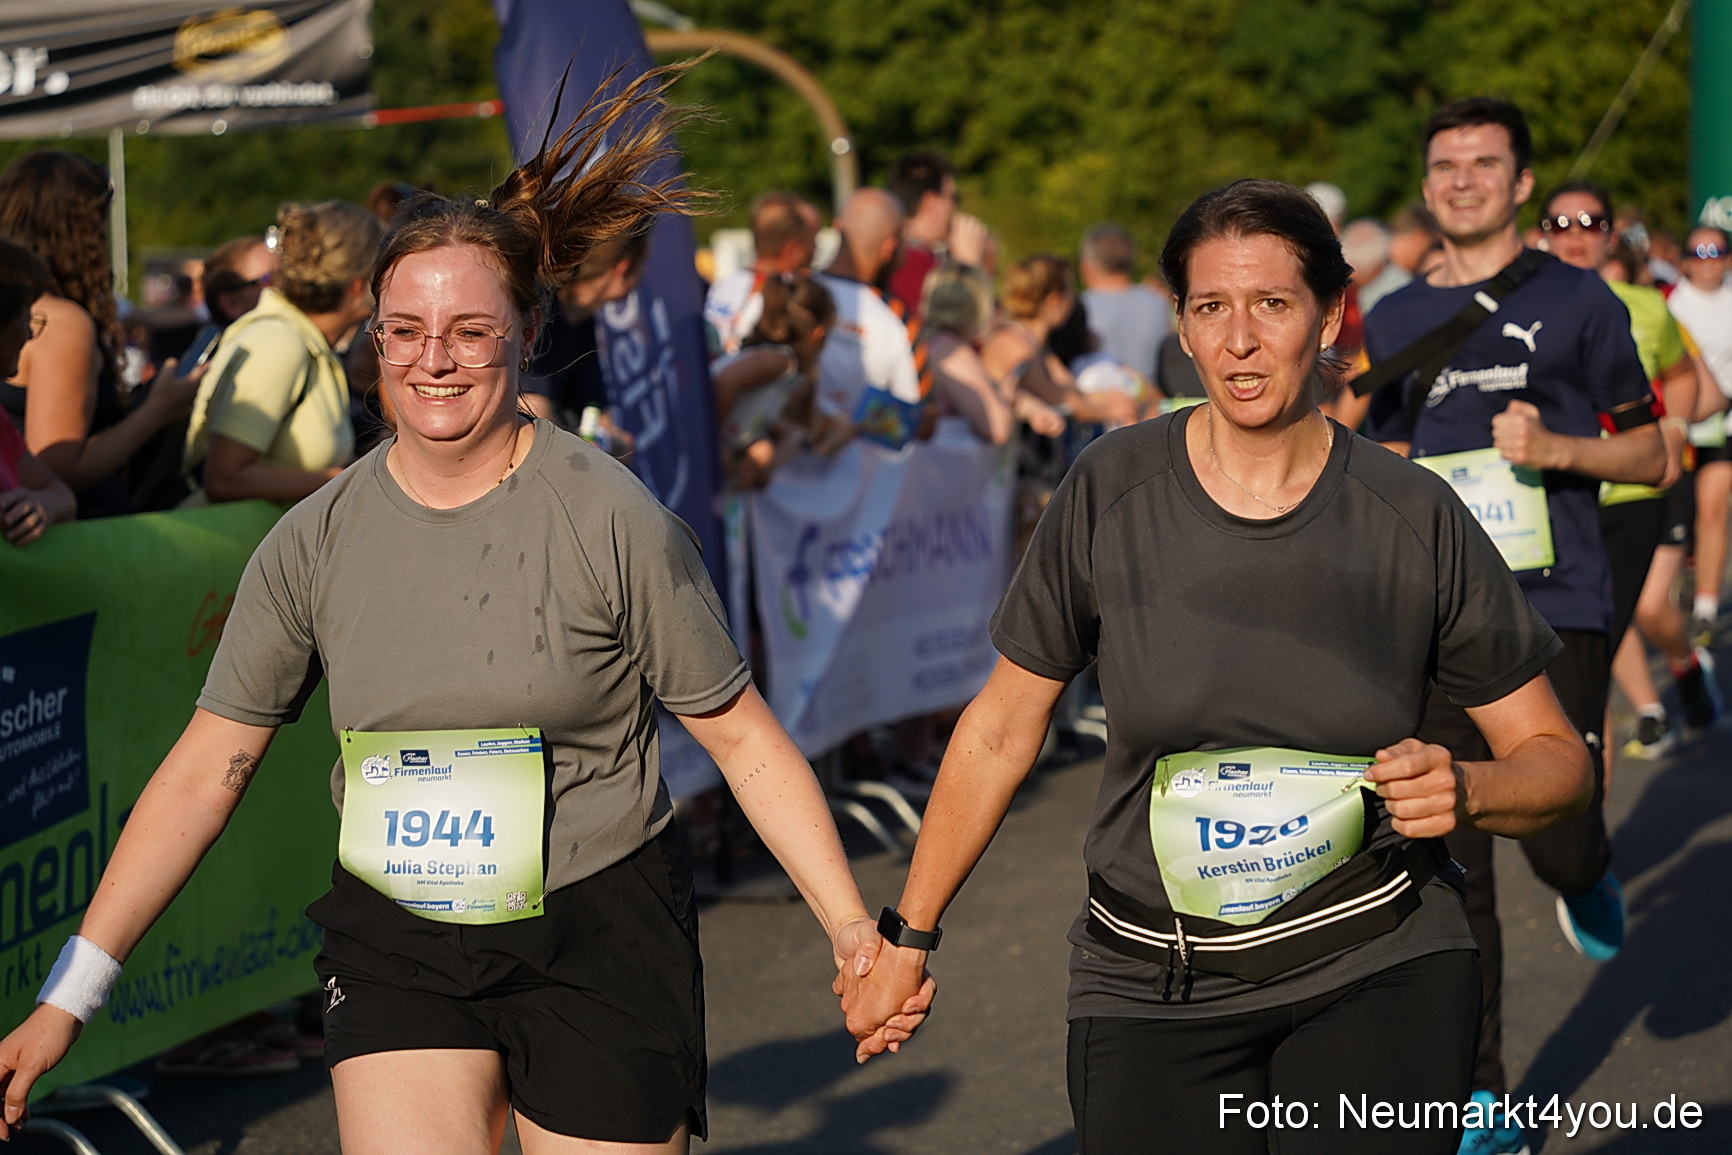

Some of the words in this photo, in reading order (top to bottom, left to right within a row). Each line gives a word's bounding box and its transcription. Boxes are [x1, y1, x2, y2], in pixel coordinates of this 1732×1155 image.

[394, 764, 453, 777] Firmenlauf
[418, 774, 452, 783] neumarkt
[1208, 781, 1275, 791] Firmenlauf
[384, 810, 495, 848] 1944
[1197, 859, 1262, 880] Kerstin
[1263, 839, 1333, 872] Brückel
[384, 859, 422, 875] Julia
[426, 859, 498, 878] Stephan
[1266, 873, 1292, 883] Apotheke
